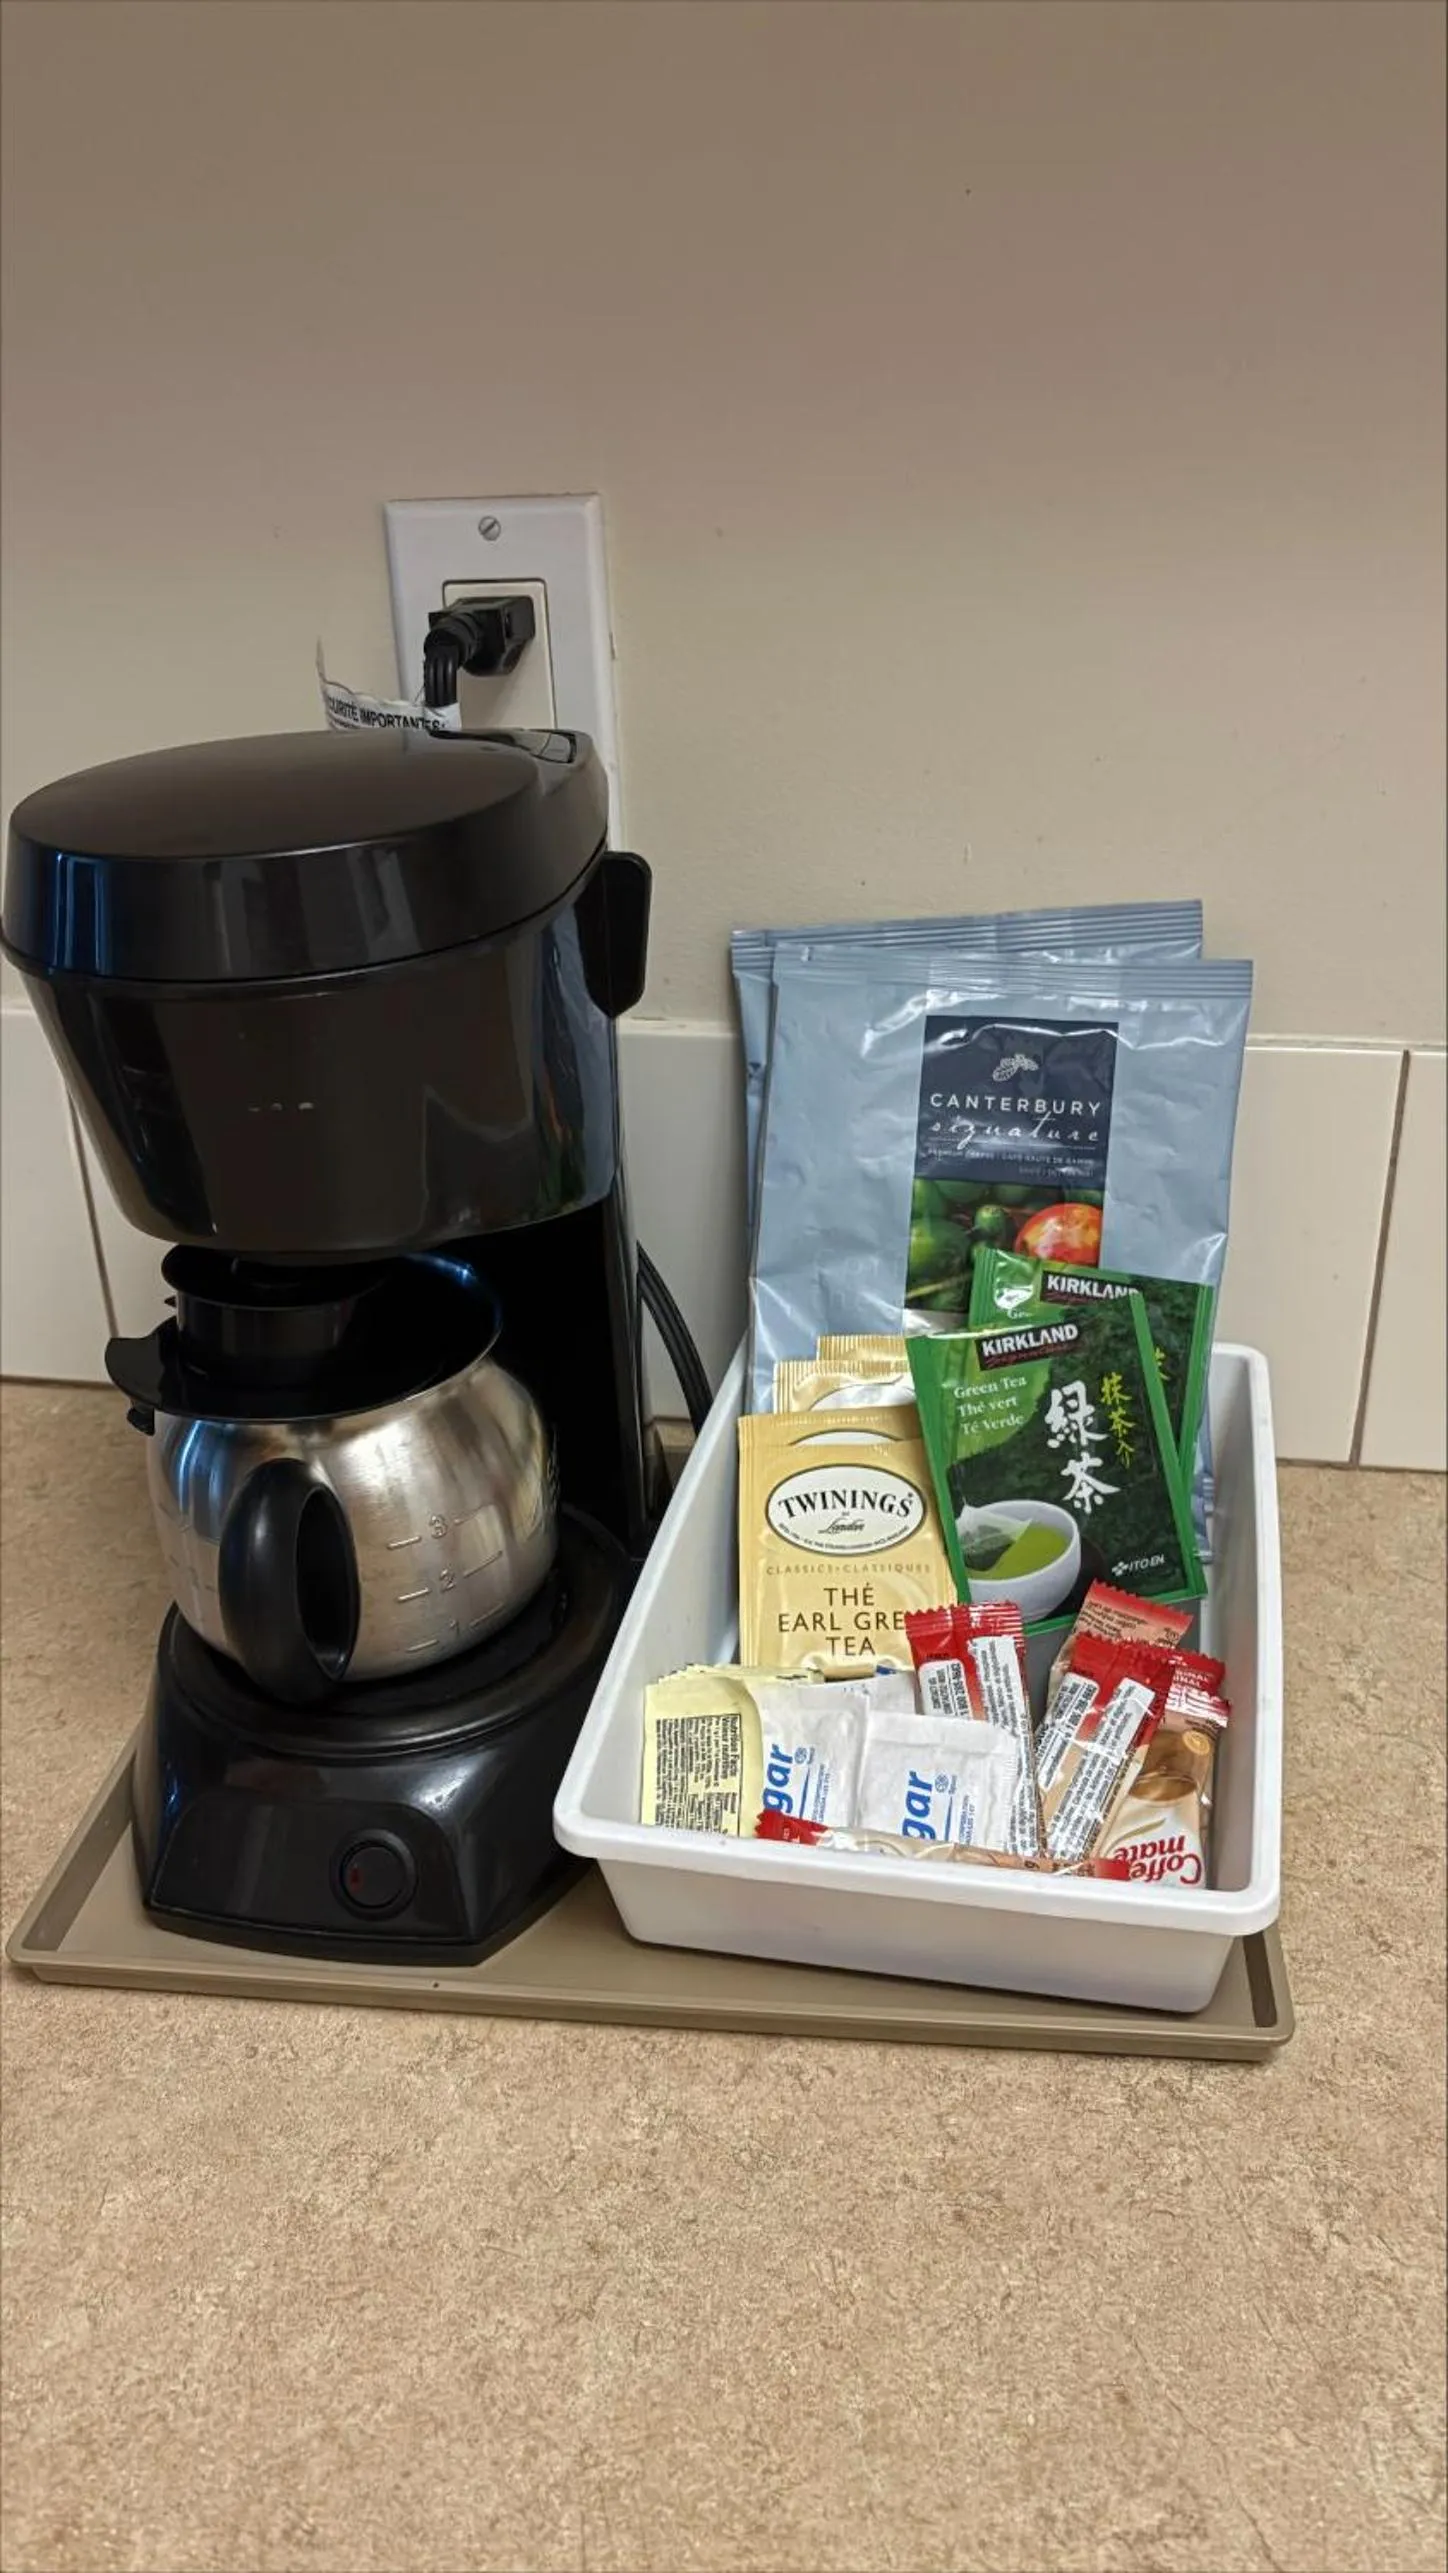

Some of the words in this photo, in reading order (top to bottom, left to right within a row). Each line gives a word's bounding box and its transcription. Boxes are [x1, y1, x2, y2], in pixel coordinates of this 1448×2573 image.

[930, 1093, 1101, 1114] CANTERBURY
[982, 1324, 1079, 1357] KIRKLAND
[954, 1382, 998, 1399] Green
[1000, 1376, 1027, 1390] Tea
[957, 1401, 985, 1417] Thé
[989, 1396, 1017, 1410] vert
[982, 1413, 1024, 1430] Verde
[1046, 1380, 1120, 1514] 緑茶
[778, 1489, 914, 1519] TWININGS
[430, 1514, 447, 1539] 3
[440, 1568, 456, 1592] 2
[823, 1583, 875, 1607] THÉ
[778, 1612, 842, 1633] EARL
[853, 1611, 905, 1632] GRE
[826, 1636, 876, 1657] TEA
[1113, 1833, 1187, 1863] mate
[1129, 1852, 1203, 1886] Coffe
